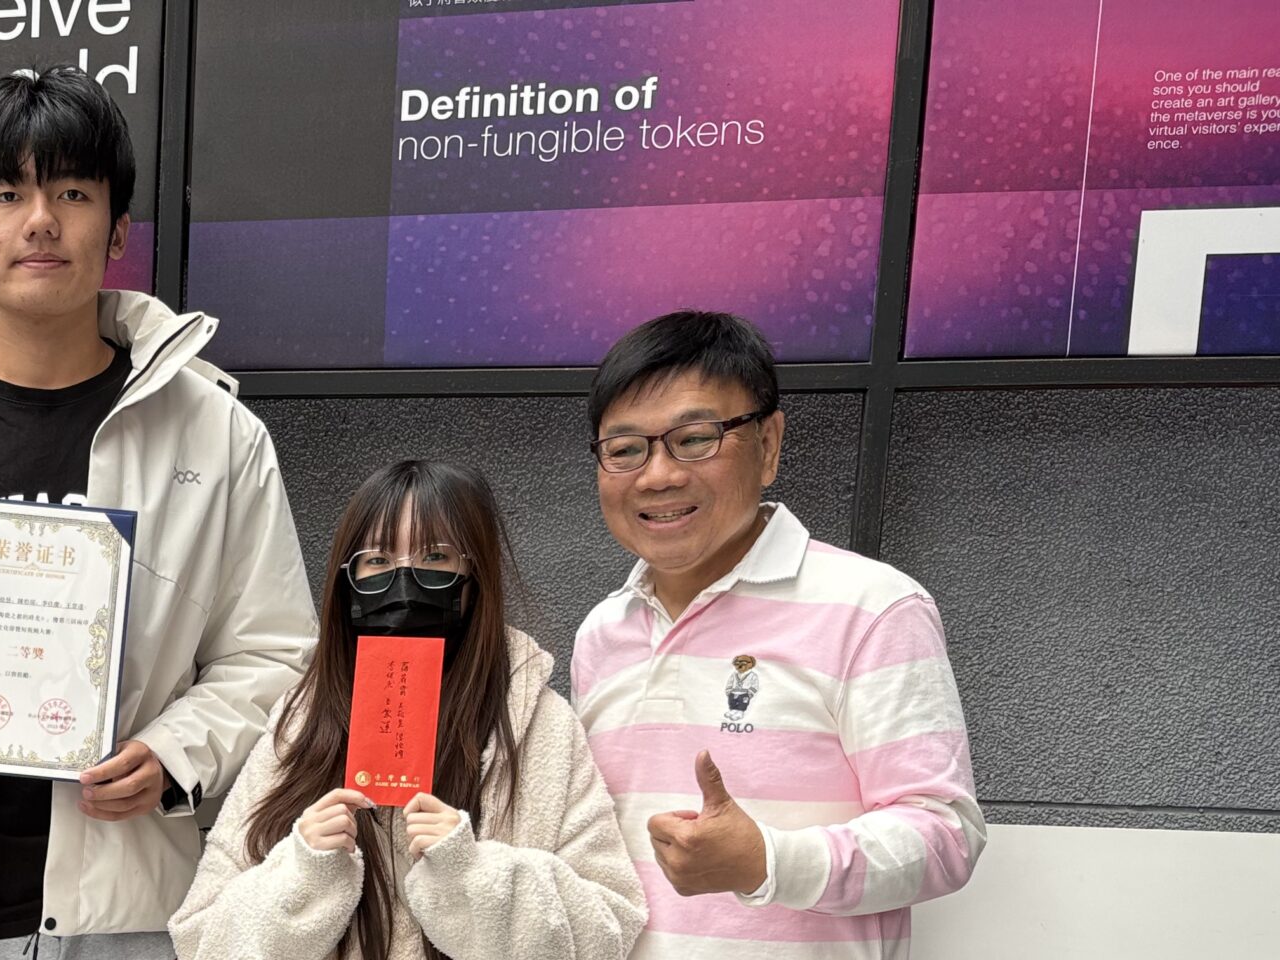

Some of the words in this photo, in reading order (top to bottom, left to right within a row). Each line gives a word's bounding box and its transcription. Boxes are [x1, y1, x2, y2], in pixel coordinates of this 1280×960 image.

[1154, 70, 1182, 82] One
[1185, 69, 1198, 81] of
[1202, 68, 1222, 80] the
[1226, 67, 1259, 79] main
[1152, 86, 1183, 96] sons
[1187, 85, 1211, 97] you
[1215, 80, 1260, 93] should
[401, 82, 599, 121] Definition
[615, 77, 658, 110] of
[1151, 98, 1193, 109] create
[1196, 97, 1213, 107] an
[1216, 96, 1234, 107] art
[1238, 94, 1280, 109] gallery
[1150, 111, 1170, 123] the
[1174, 111, 1243, 122] metaverse
[1246, 108, 1257, 119] is
[1149, 124, 1188, 136] virtual
[398, 119, 625, 161] non-fungible
[639, 115, 765, 149] tokens
[1147, 139, 1183, 150] ence.
[720, 722, 754, 733] POLO
